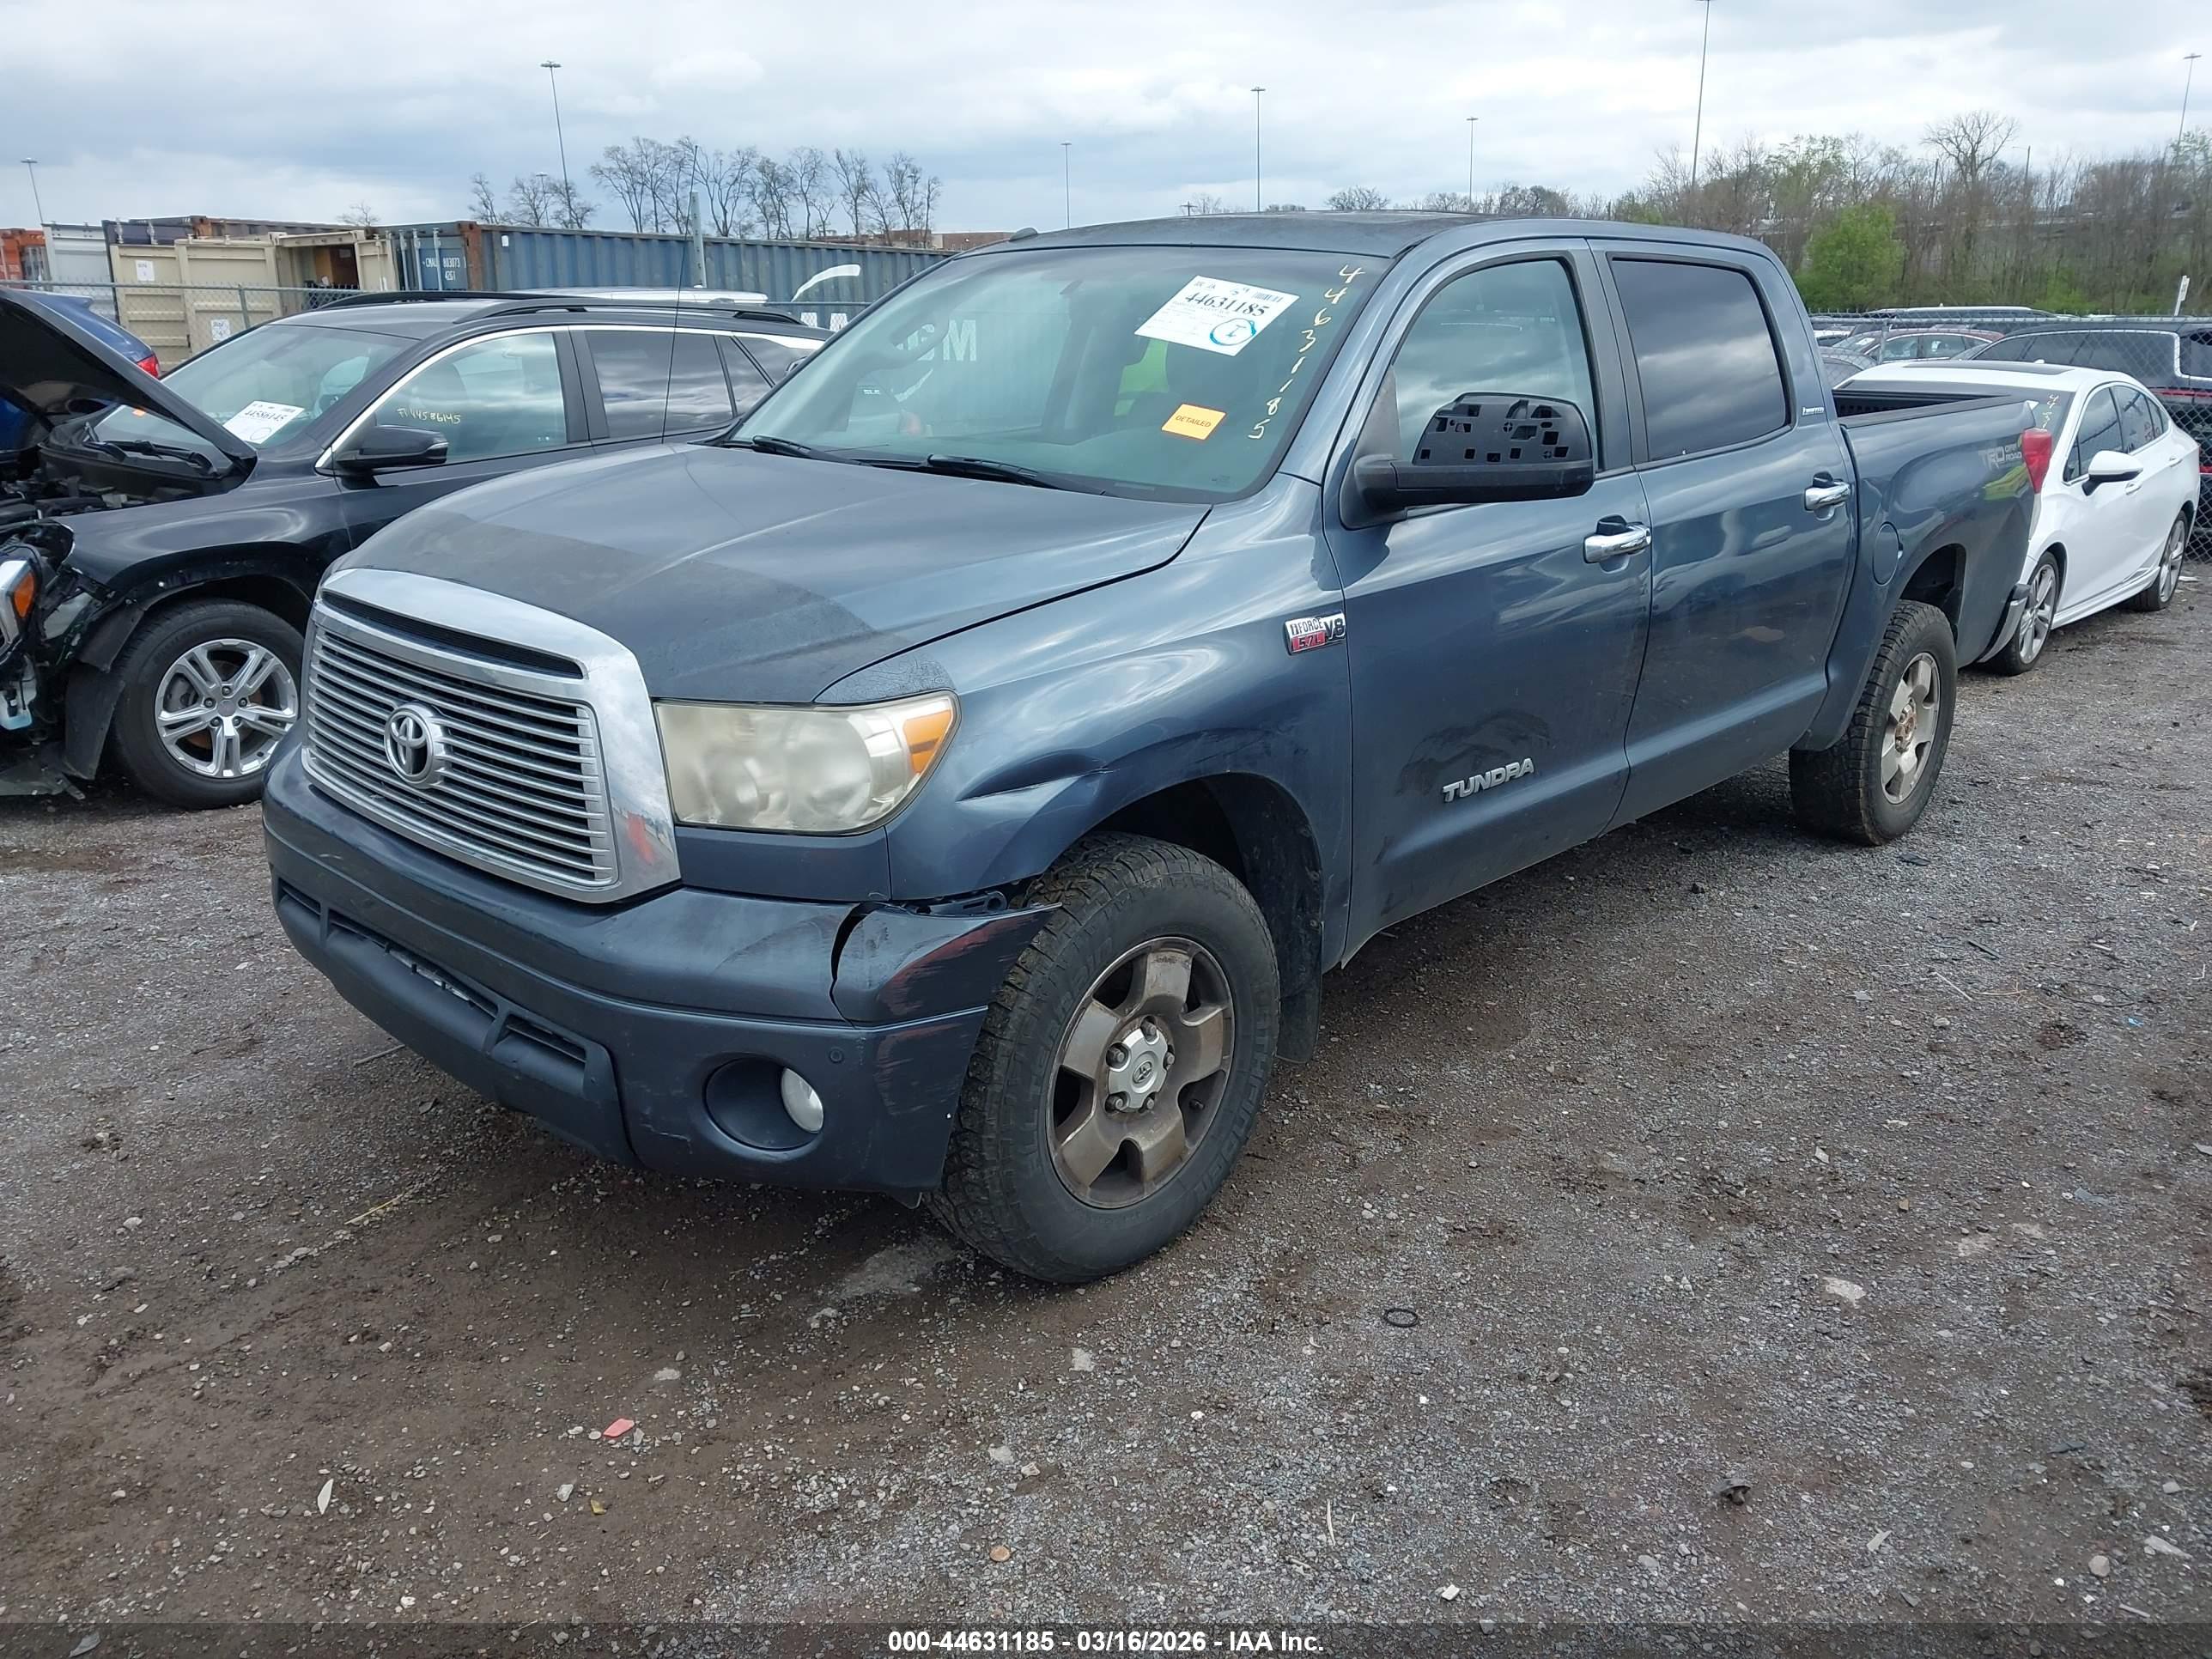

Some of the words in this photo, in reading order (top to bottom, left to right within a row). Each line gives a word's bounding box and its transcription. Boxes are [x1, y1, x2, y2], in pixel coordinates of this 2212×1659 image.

[1185, 292, 1270, 317] 44631185
[1175, 415, 1212, 428] DETAILED
[1323, 617, 1346, 640] V8
[1443, 757, 1534, 803] TUNDRA
